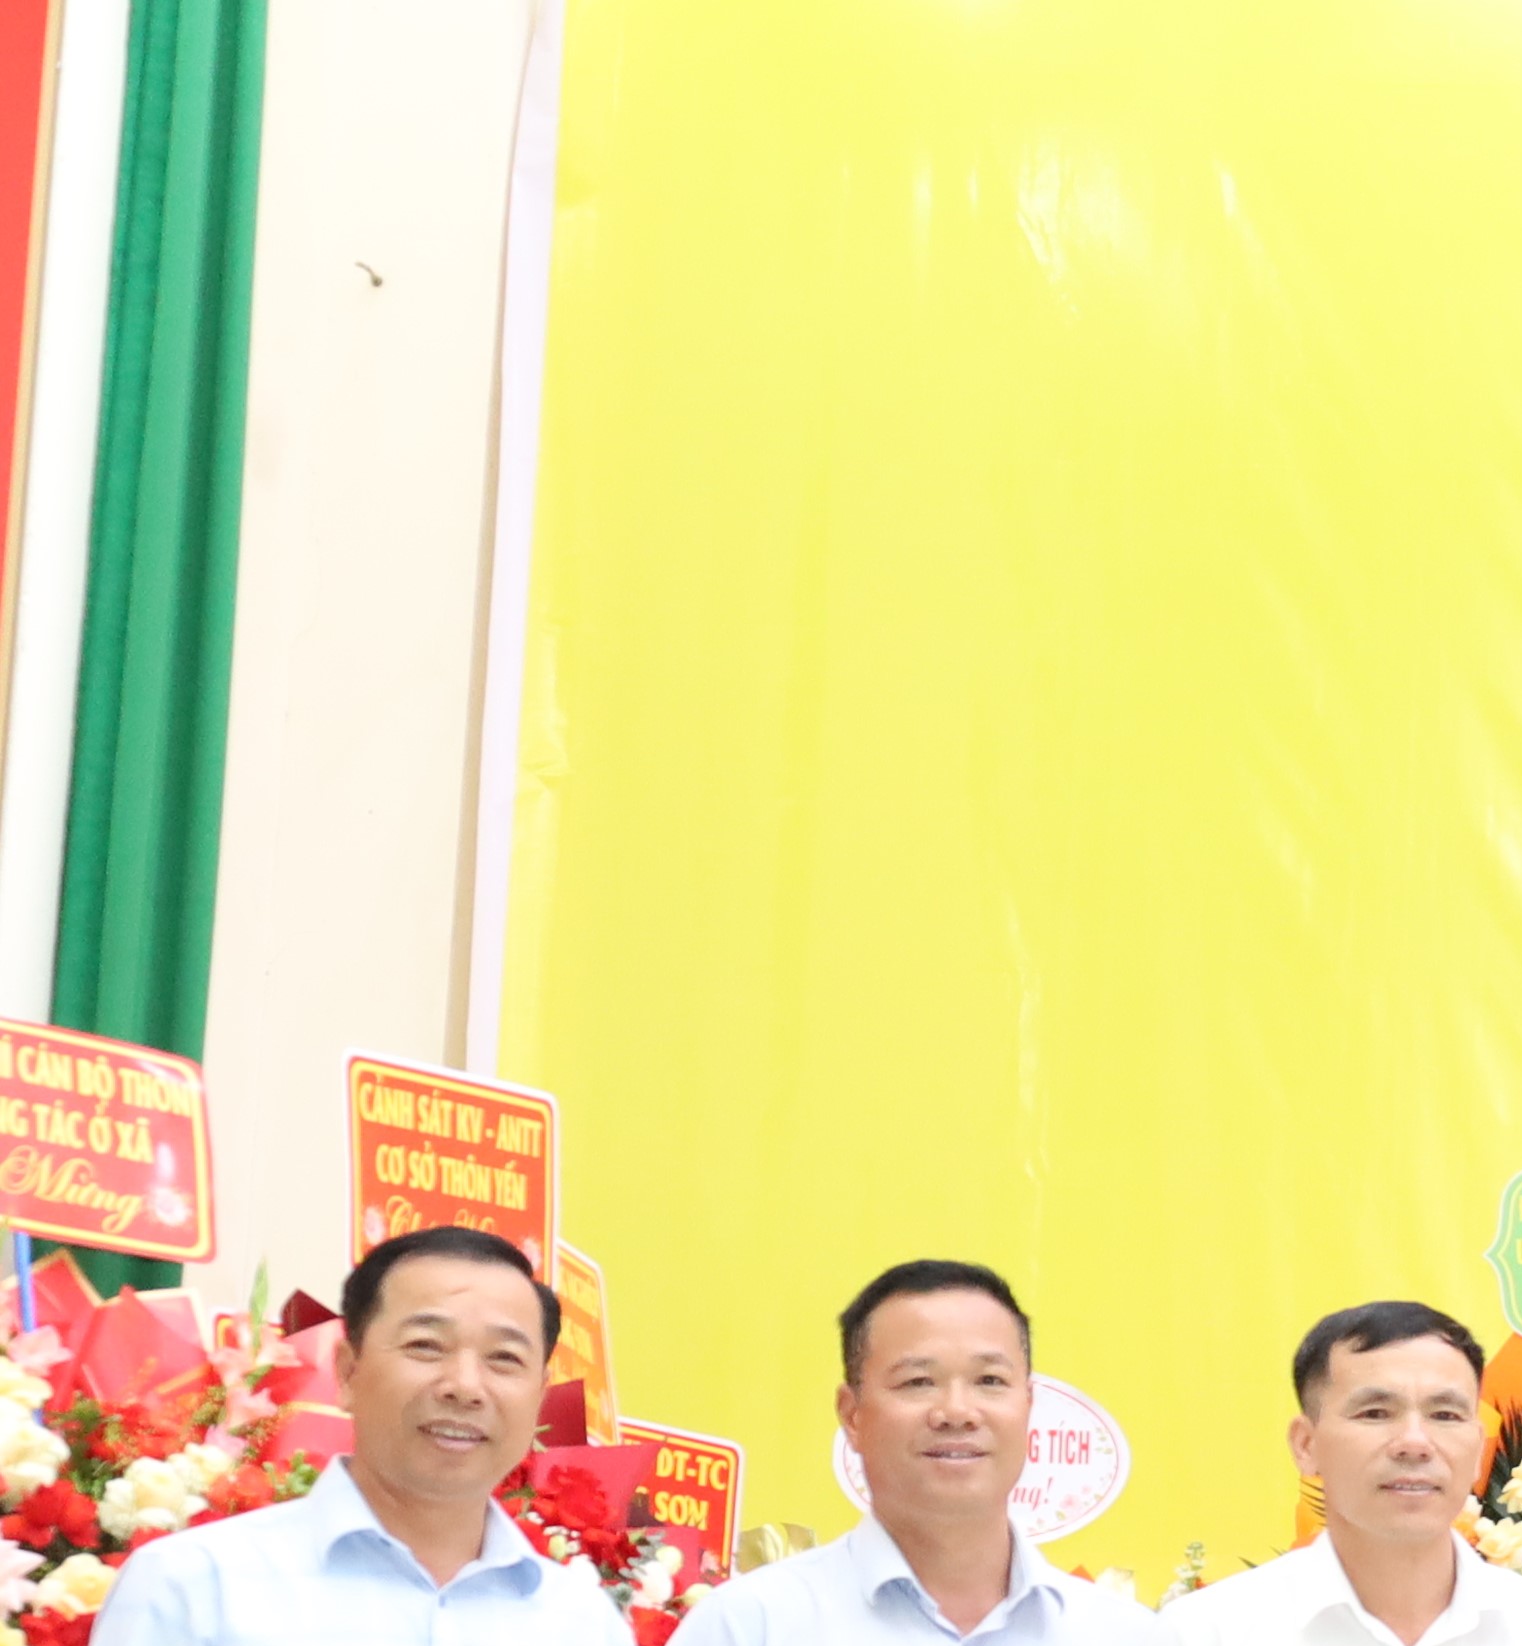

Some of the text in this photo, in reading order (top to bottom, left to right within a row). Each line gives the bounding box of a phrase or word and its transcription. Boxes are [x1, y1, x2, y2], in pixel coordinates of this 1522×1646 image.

[17, 1043, 73, 1091] CÁN
[77, 1056, 115, 1099] BỘ
[33, 1100, 85, 1148] TÁC
[88, 1100, 113, 1154] Ở
[115, 1117, 154, 1164] XÃ
[360, 1073, 415, 1130] CẢNH
[418, 1088, 453, 1138] SÁT
[456, 1103, 484, 1144] KV
[496, 1113, 543, 1158] ANTT
[375, 1141, 527, 1212] CƠ SỞ THÔN YẾN
[1048, 1420, 1091, 1464] TÍCH
[654, 1490, 709, 1532] SƠN
